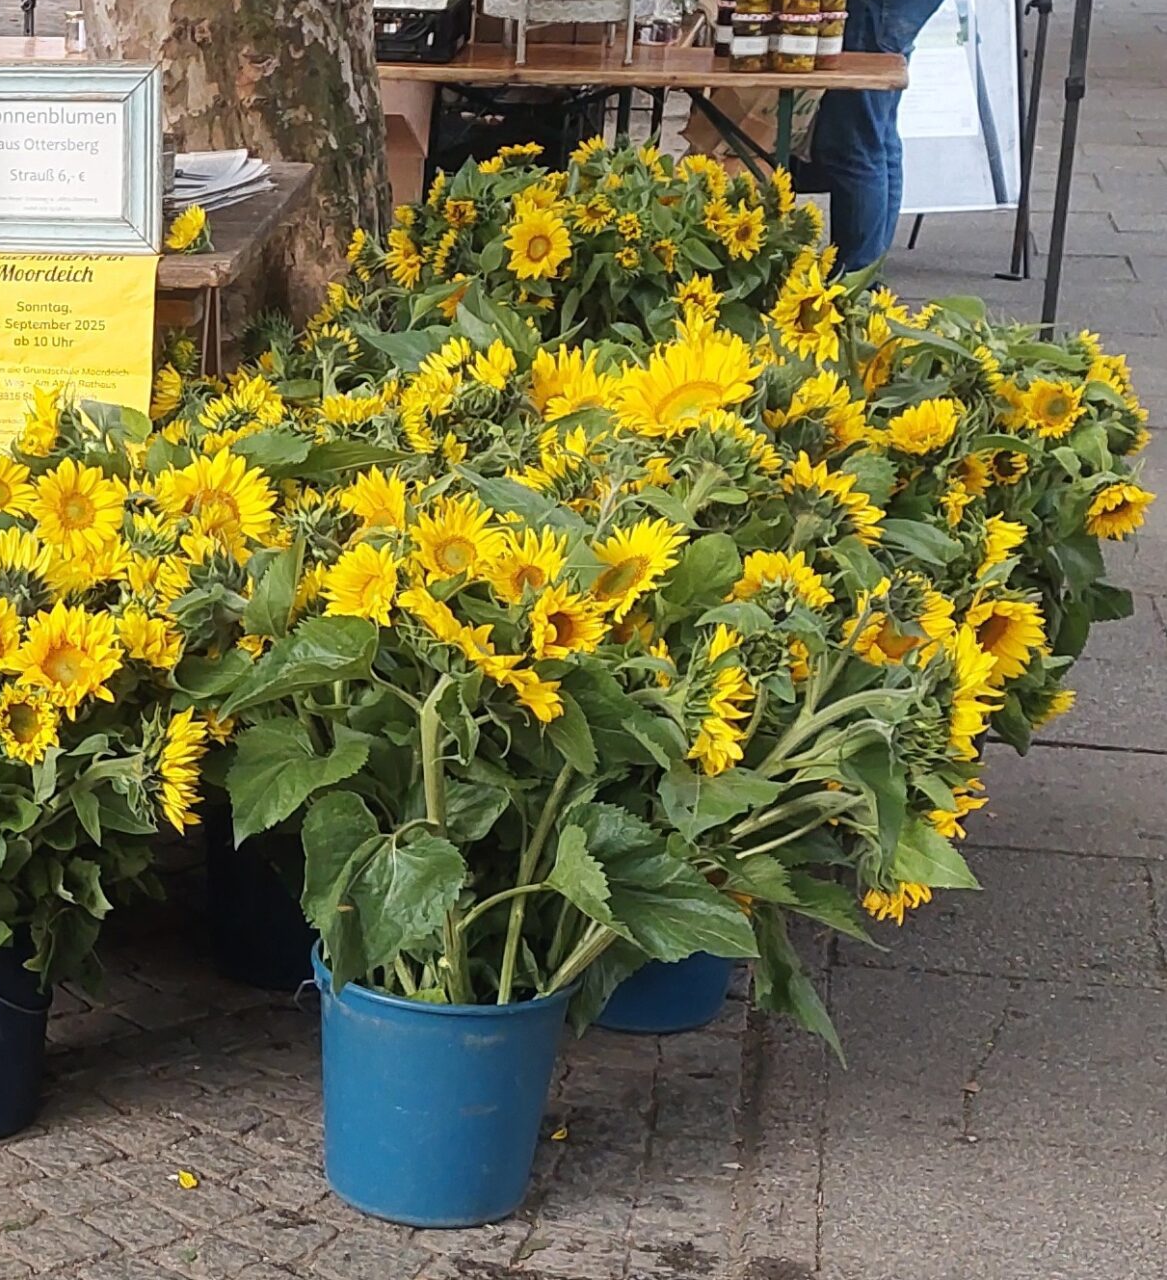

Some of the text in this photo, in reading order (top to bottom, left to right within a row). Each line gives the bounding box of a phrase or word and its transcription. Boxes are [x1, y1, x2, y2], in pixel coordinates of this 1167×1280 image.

[23, 138, 99, 155] Ottersberg
[10, 169, 53, 182] Strauß
[5, 319, 71, 332] September
[74, 320, 105, 331] 2025
[14, 337, 75, 348] ab 10 Uhr
